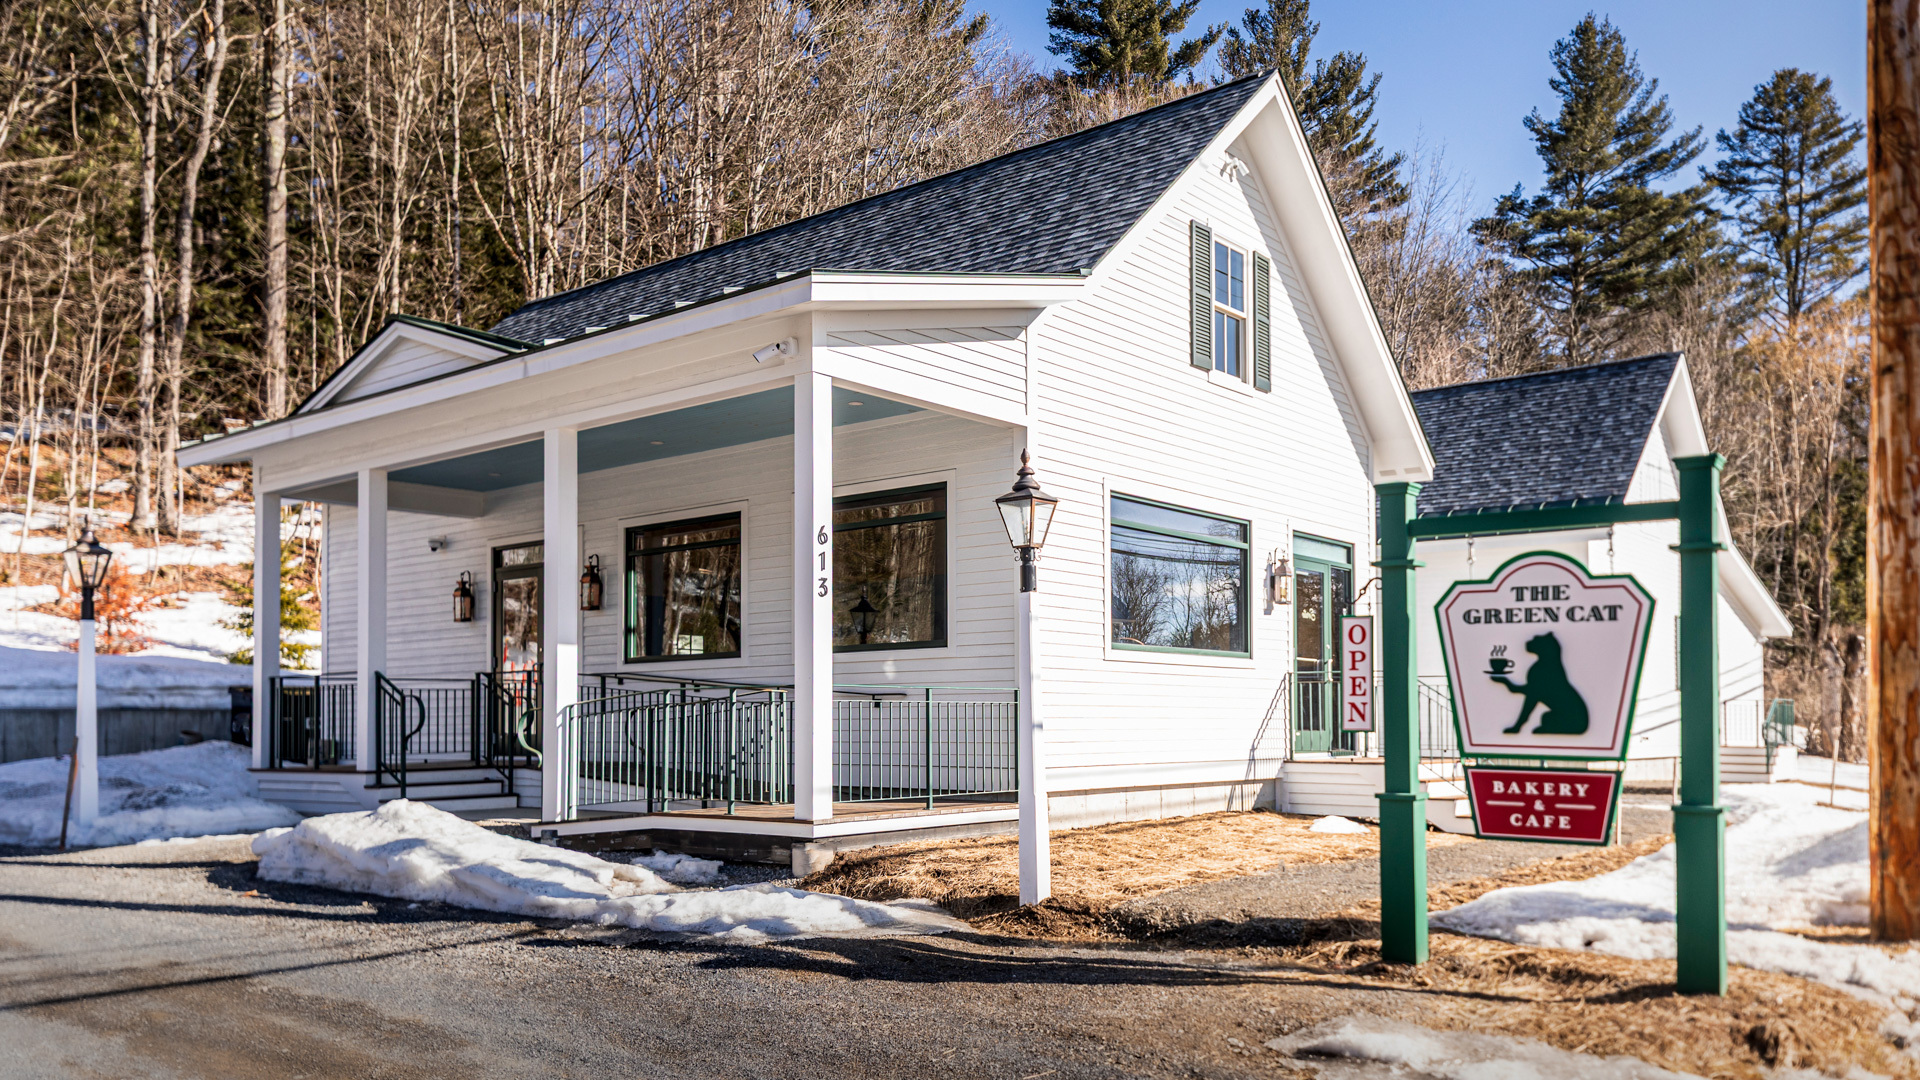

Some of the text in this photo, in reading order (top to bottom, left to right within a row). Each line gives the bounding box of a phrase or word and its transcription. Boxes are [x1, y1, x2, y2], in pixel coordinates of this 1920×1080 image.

[818, 525, 828, 597] 613
[1511, 585, 1570, 602] THE
[1463, 605, 1623, 624] GREEN CAT
[1348, 624, 1367, 722] OPEN
[1492, 781, 1589, 797] BAKERY
[1534, 799, 1545, 811] &
[1510, 813, 1571, 830] CAFE
